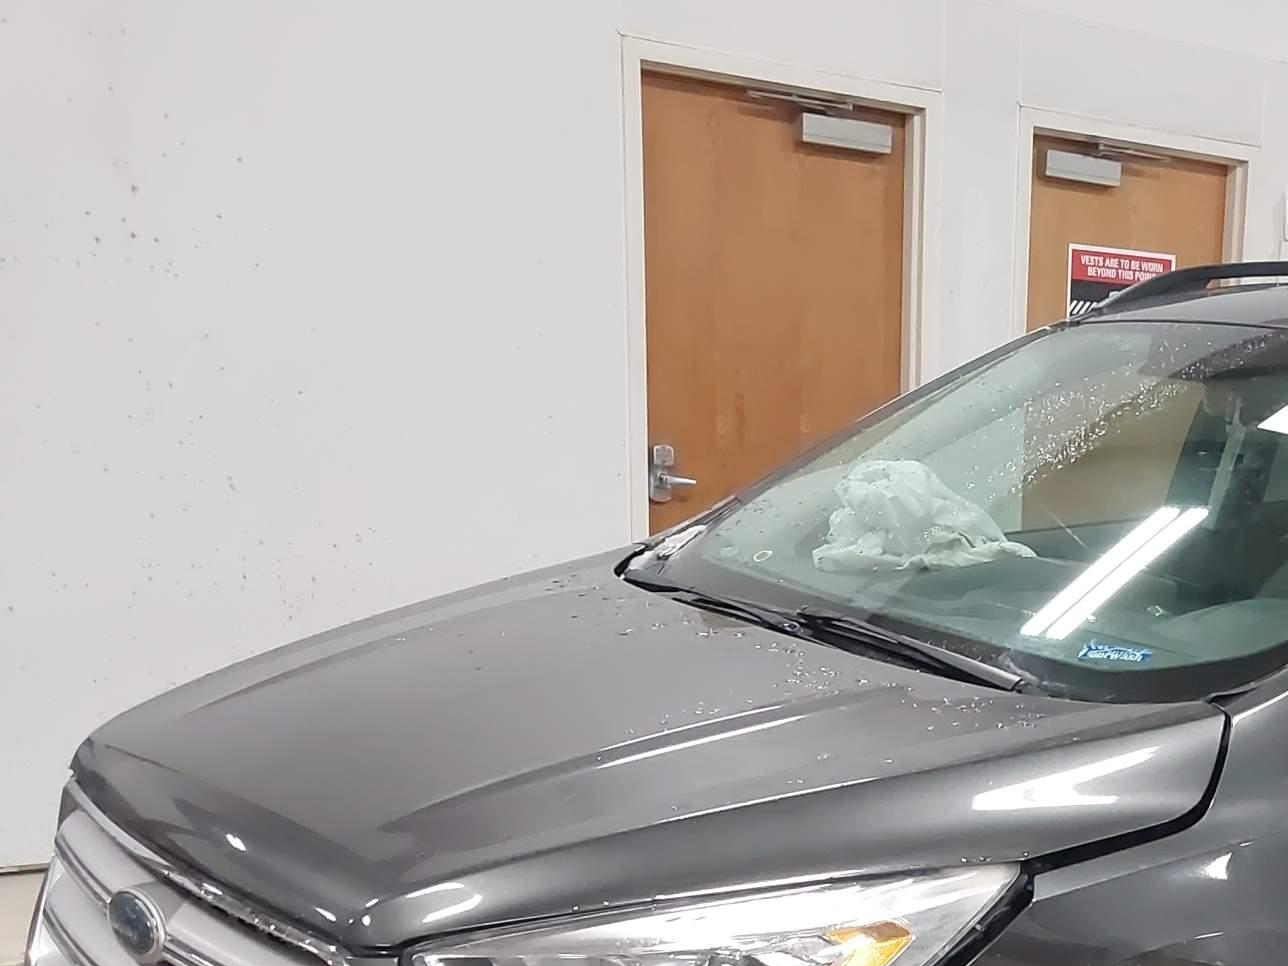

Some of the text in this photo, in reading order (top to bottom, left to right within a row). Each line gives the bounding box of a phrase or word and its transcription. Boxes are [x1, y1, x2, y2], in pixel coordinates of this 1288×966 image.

[1080, 254, 1164, 273] VESTS ARE TO BE WORN
[1087, 266, 1116, 278] BEYOND
[1118, 270, 1134, 280] THIS
